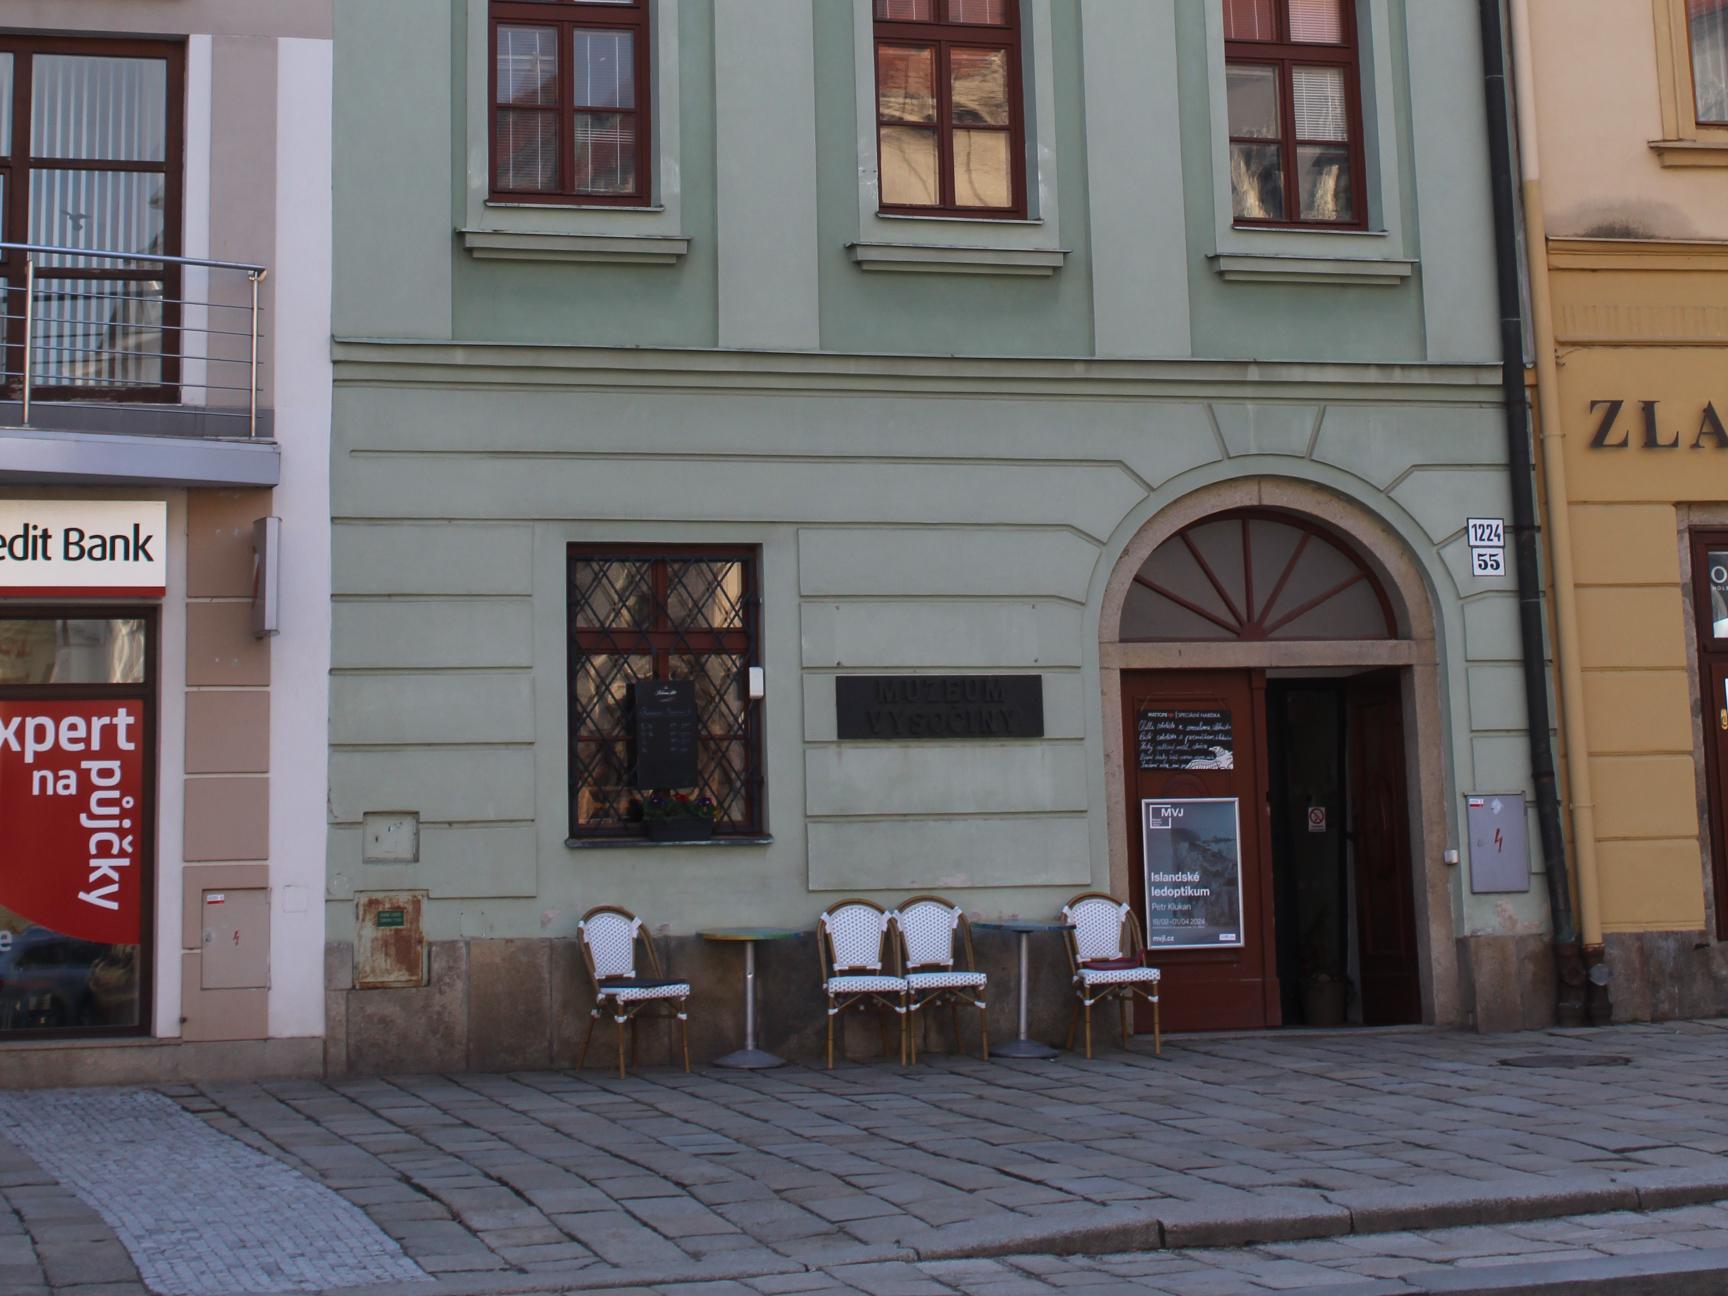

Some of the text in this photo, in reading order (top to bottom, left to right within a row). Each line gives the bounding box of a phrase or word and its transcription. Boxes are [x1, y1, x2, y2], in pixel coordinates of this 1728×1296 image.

[1589, 399, 1728, 449] ZLA
[63, 522, 155, 562] Bank
[1471, 523, 1502, 542] 1224
[1477, 553, 1501, 571] 55
[874, 678, 1008, 705] MUZEUM
[31, 769, 78, 796] na
[1161, 808, 1184, 817] MVJ
[77, 760, 135, 911] půjčky
[1151, 872, 1200, 882] Islandské
[1151, 886, 1210, 898] ledoptikum
